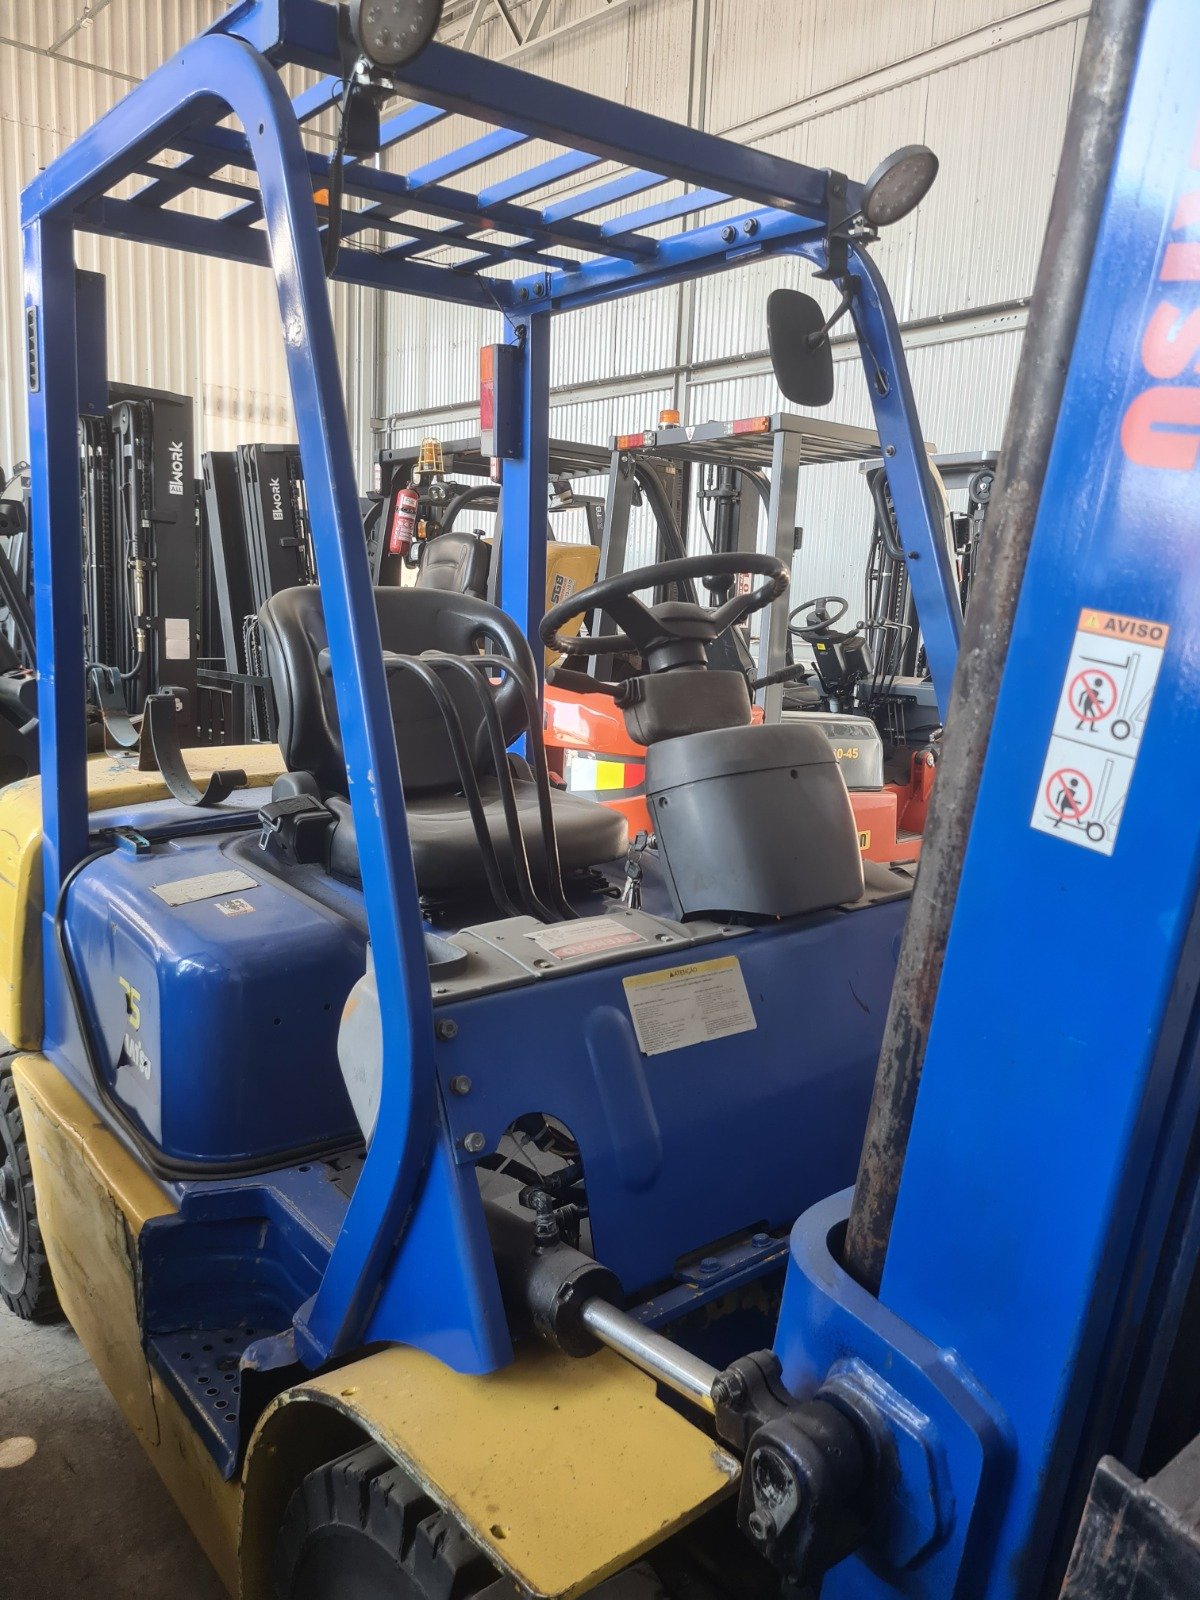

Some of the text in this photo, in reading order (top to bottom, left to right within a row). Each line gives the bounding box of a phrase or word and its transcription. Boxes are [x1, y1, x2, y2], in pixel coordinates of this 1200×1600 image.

[168, 441, 184, 485] WORK
[269, 477, 282, 512] WORK
[1104, 618, 1163, 640] AVISO
[834, 748, 859, 759] 0-45
